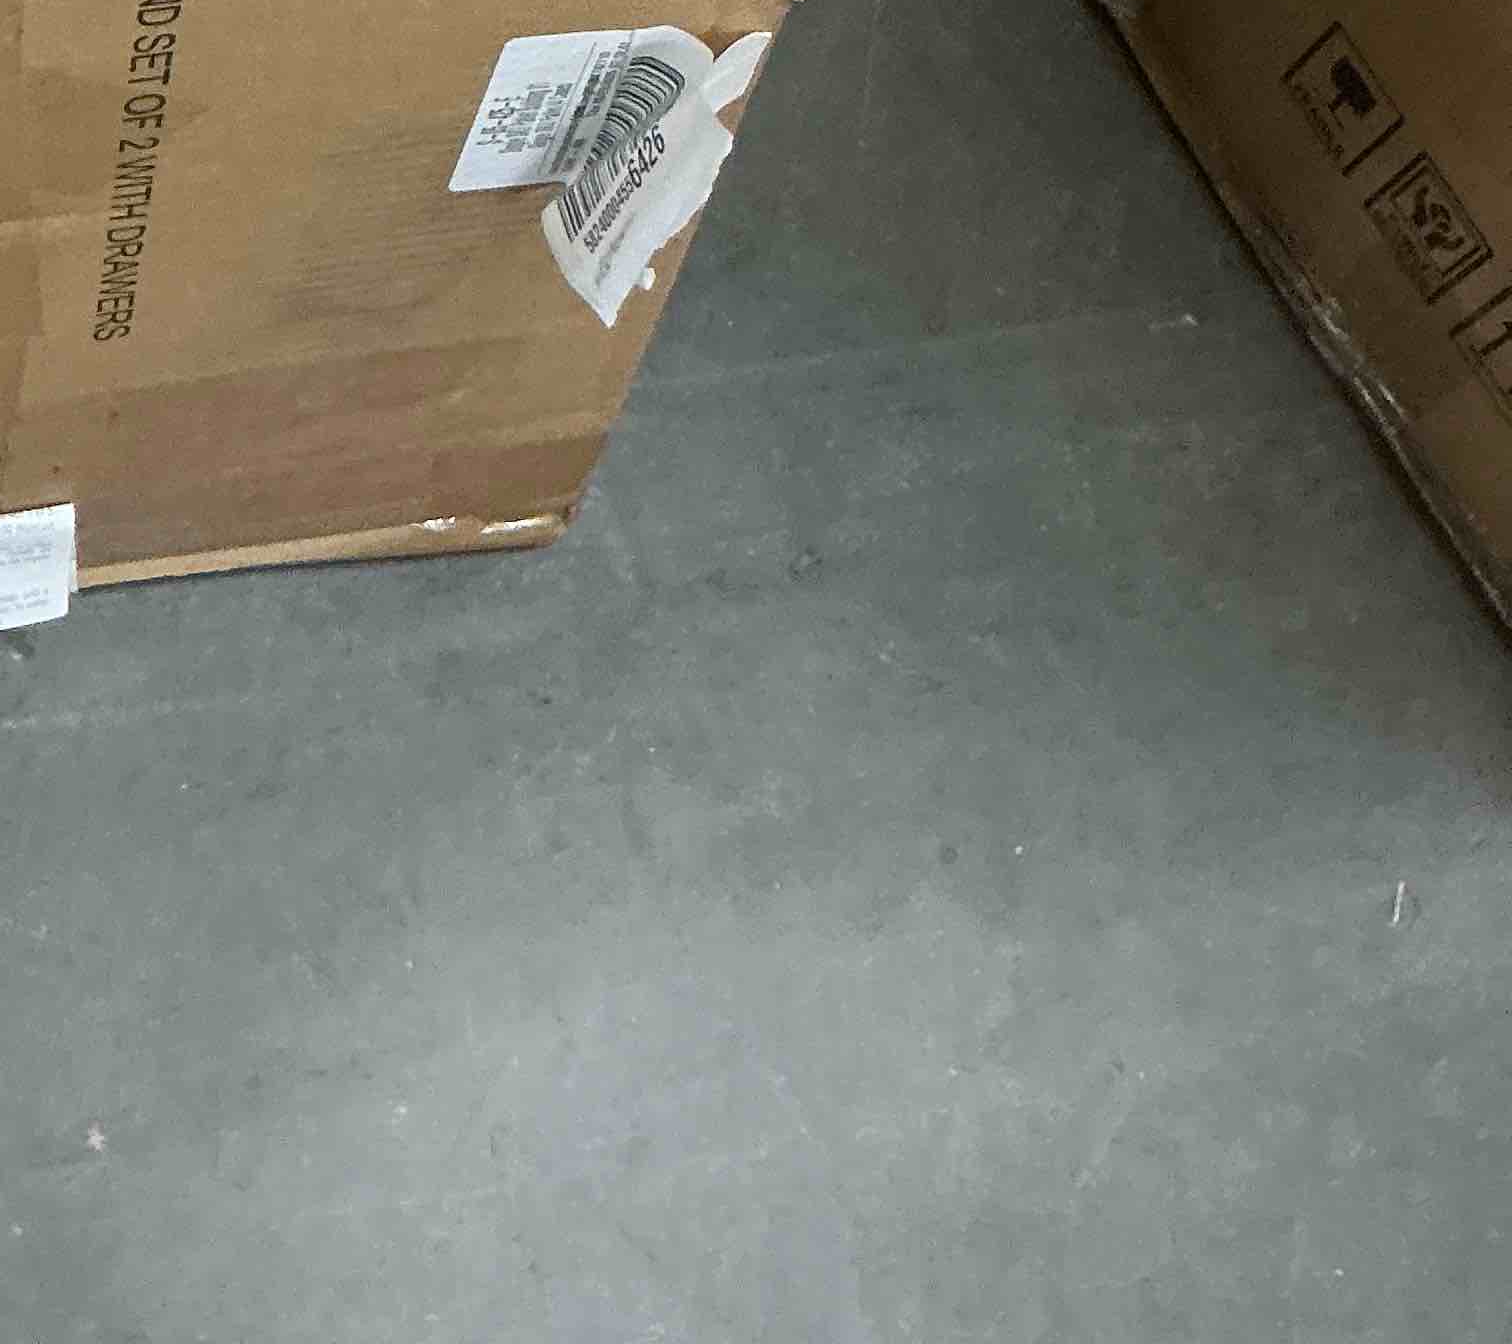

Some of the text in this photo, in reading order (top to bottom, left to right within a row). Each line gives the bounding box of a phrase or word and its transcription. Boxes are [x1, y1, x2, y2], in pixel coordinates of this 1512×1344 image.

[128, 30, 178, 85] SET
[122, 92, 169, 130] OF
[92, 222, 148, 344] DRAWERS
